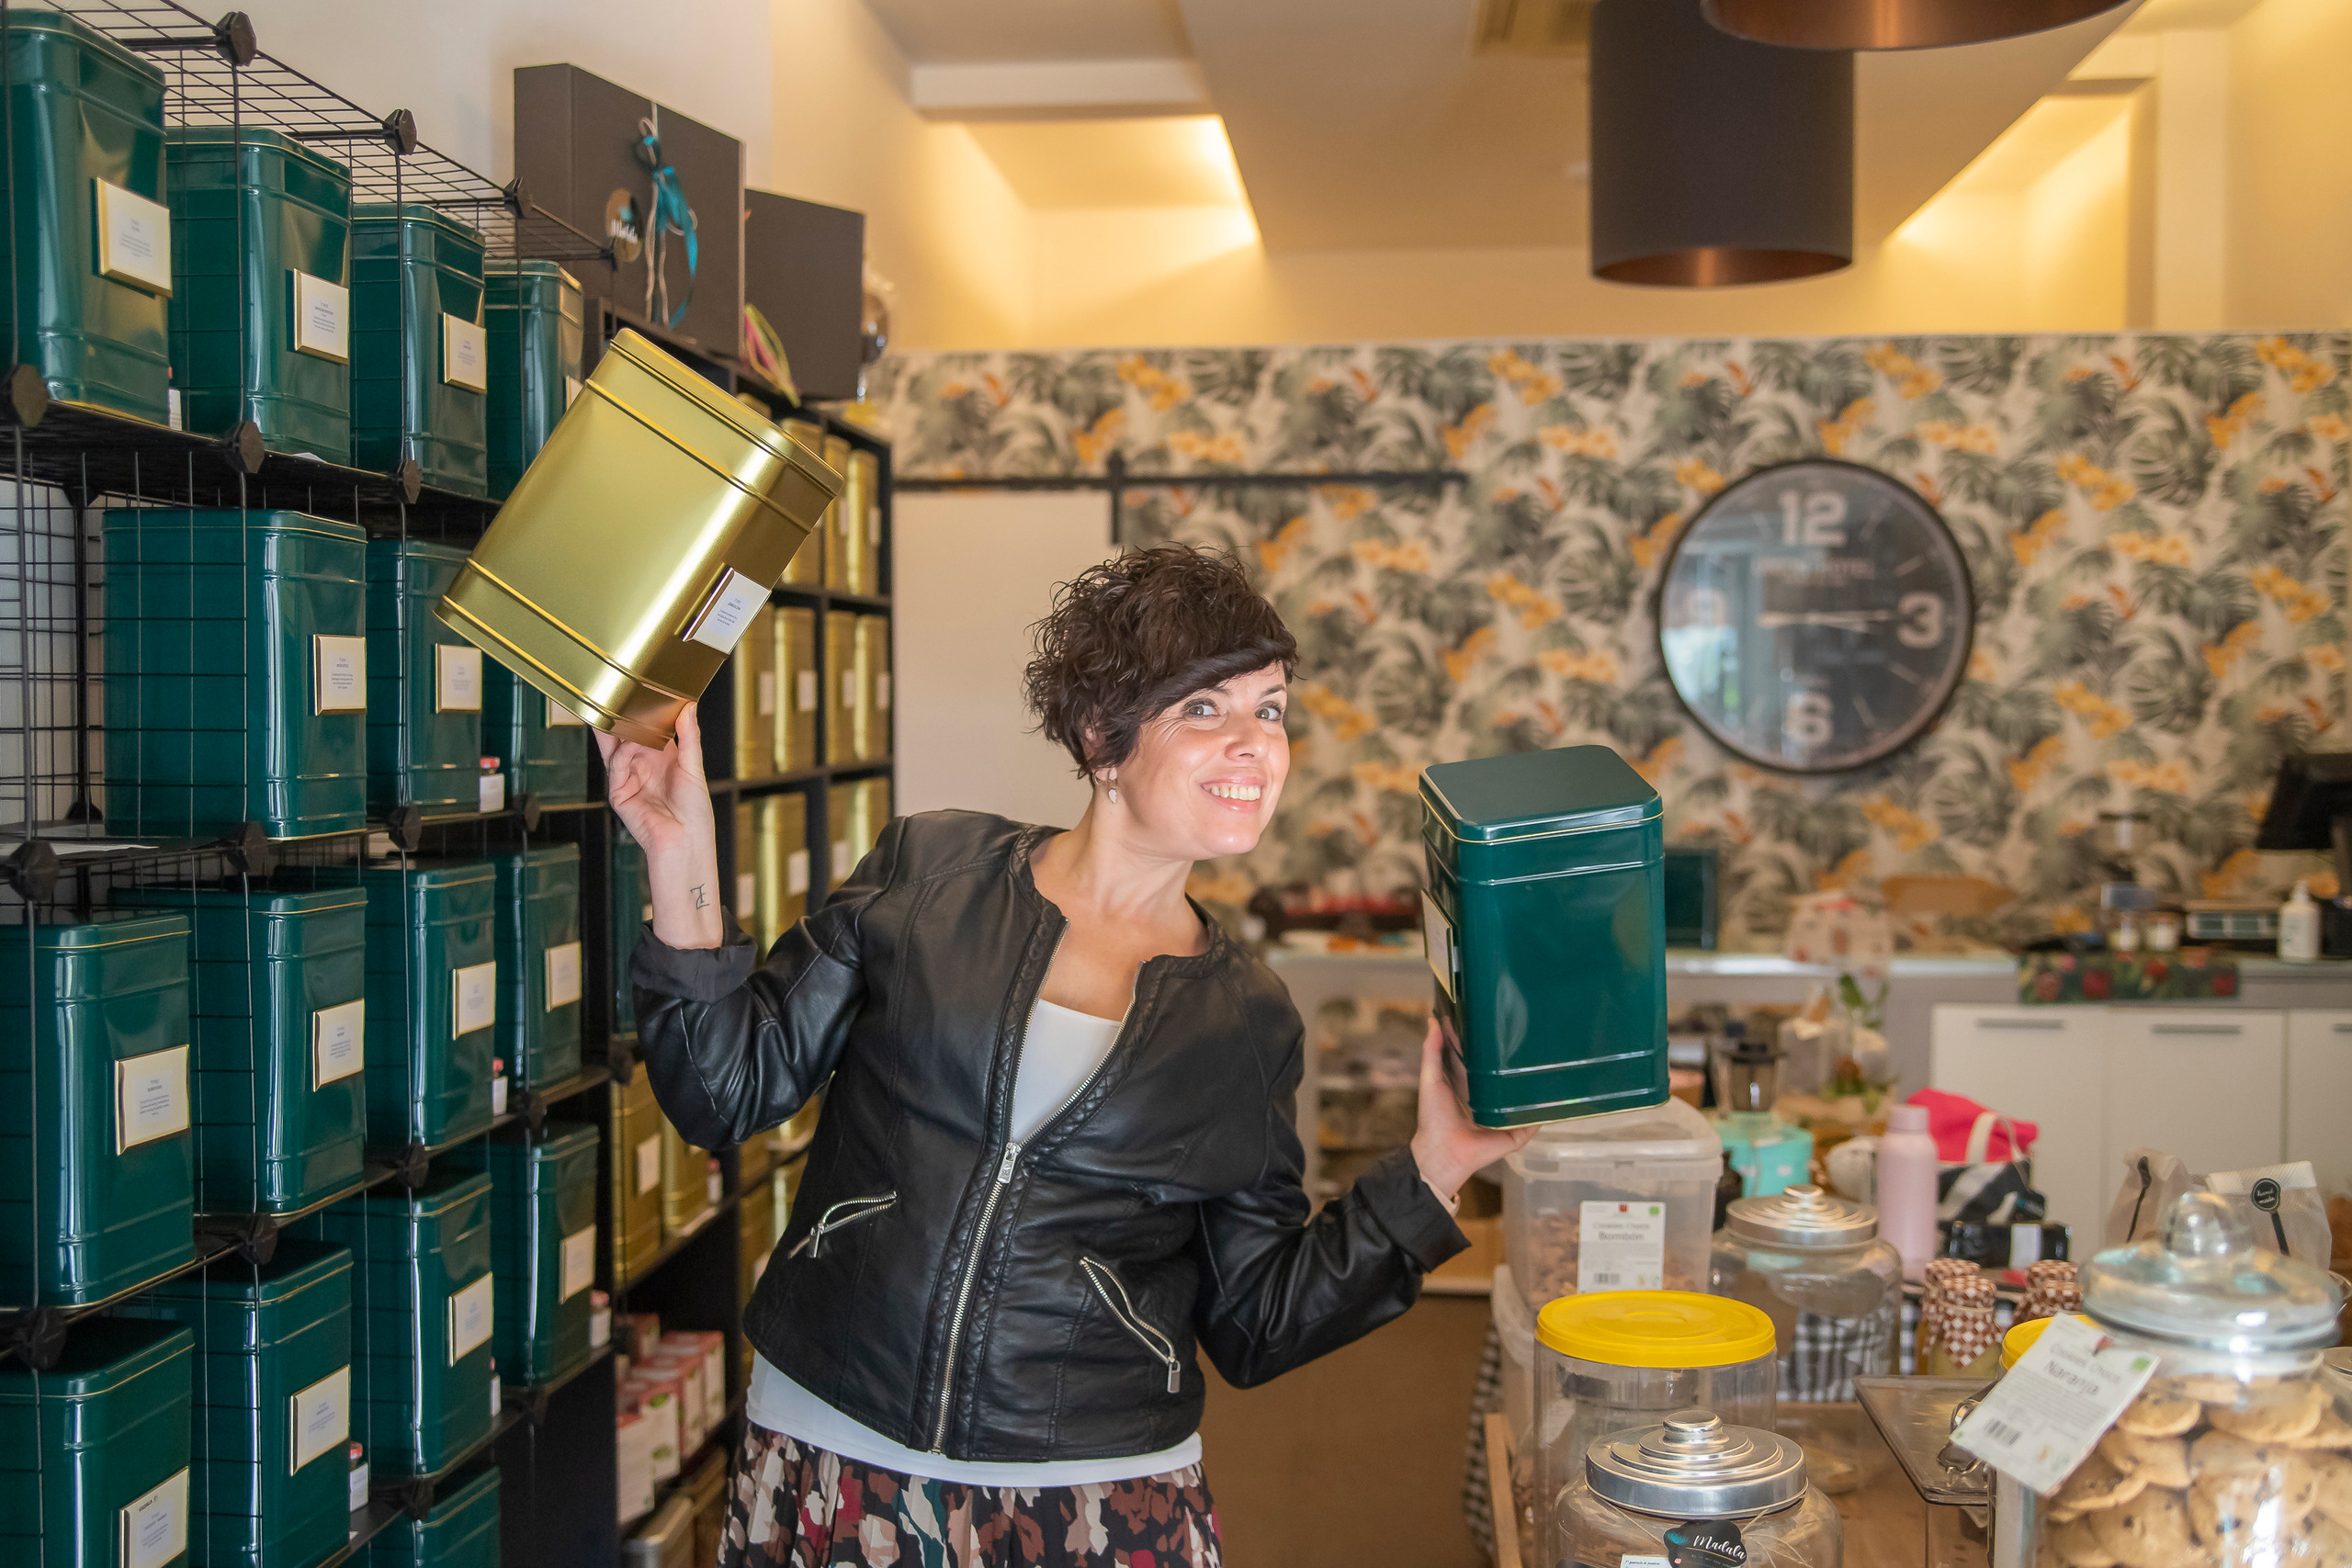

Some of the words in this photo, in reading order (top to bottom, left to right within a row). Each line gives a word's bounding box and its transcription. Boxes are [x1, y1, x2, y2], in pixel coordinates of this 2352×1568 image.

[1778, 490, 1847, 547] 12
[1897, 592, 1943, 648] 3
[1785, 693, 1834, 746] 6
[2042, 1359, 2100, 1396] Naranja
[1692, 1535, 1747, 1560] Madala
